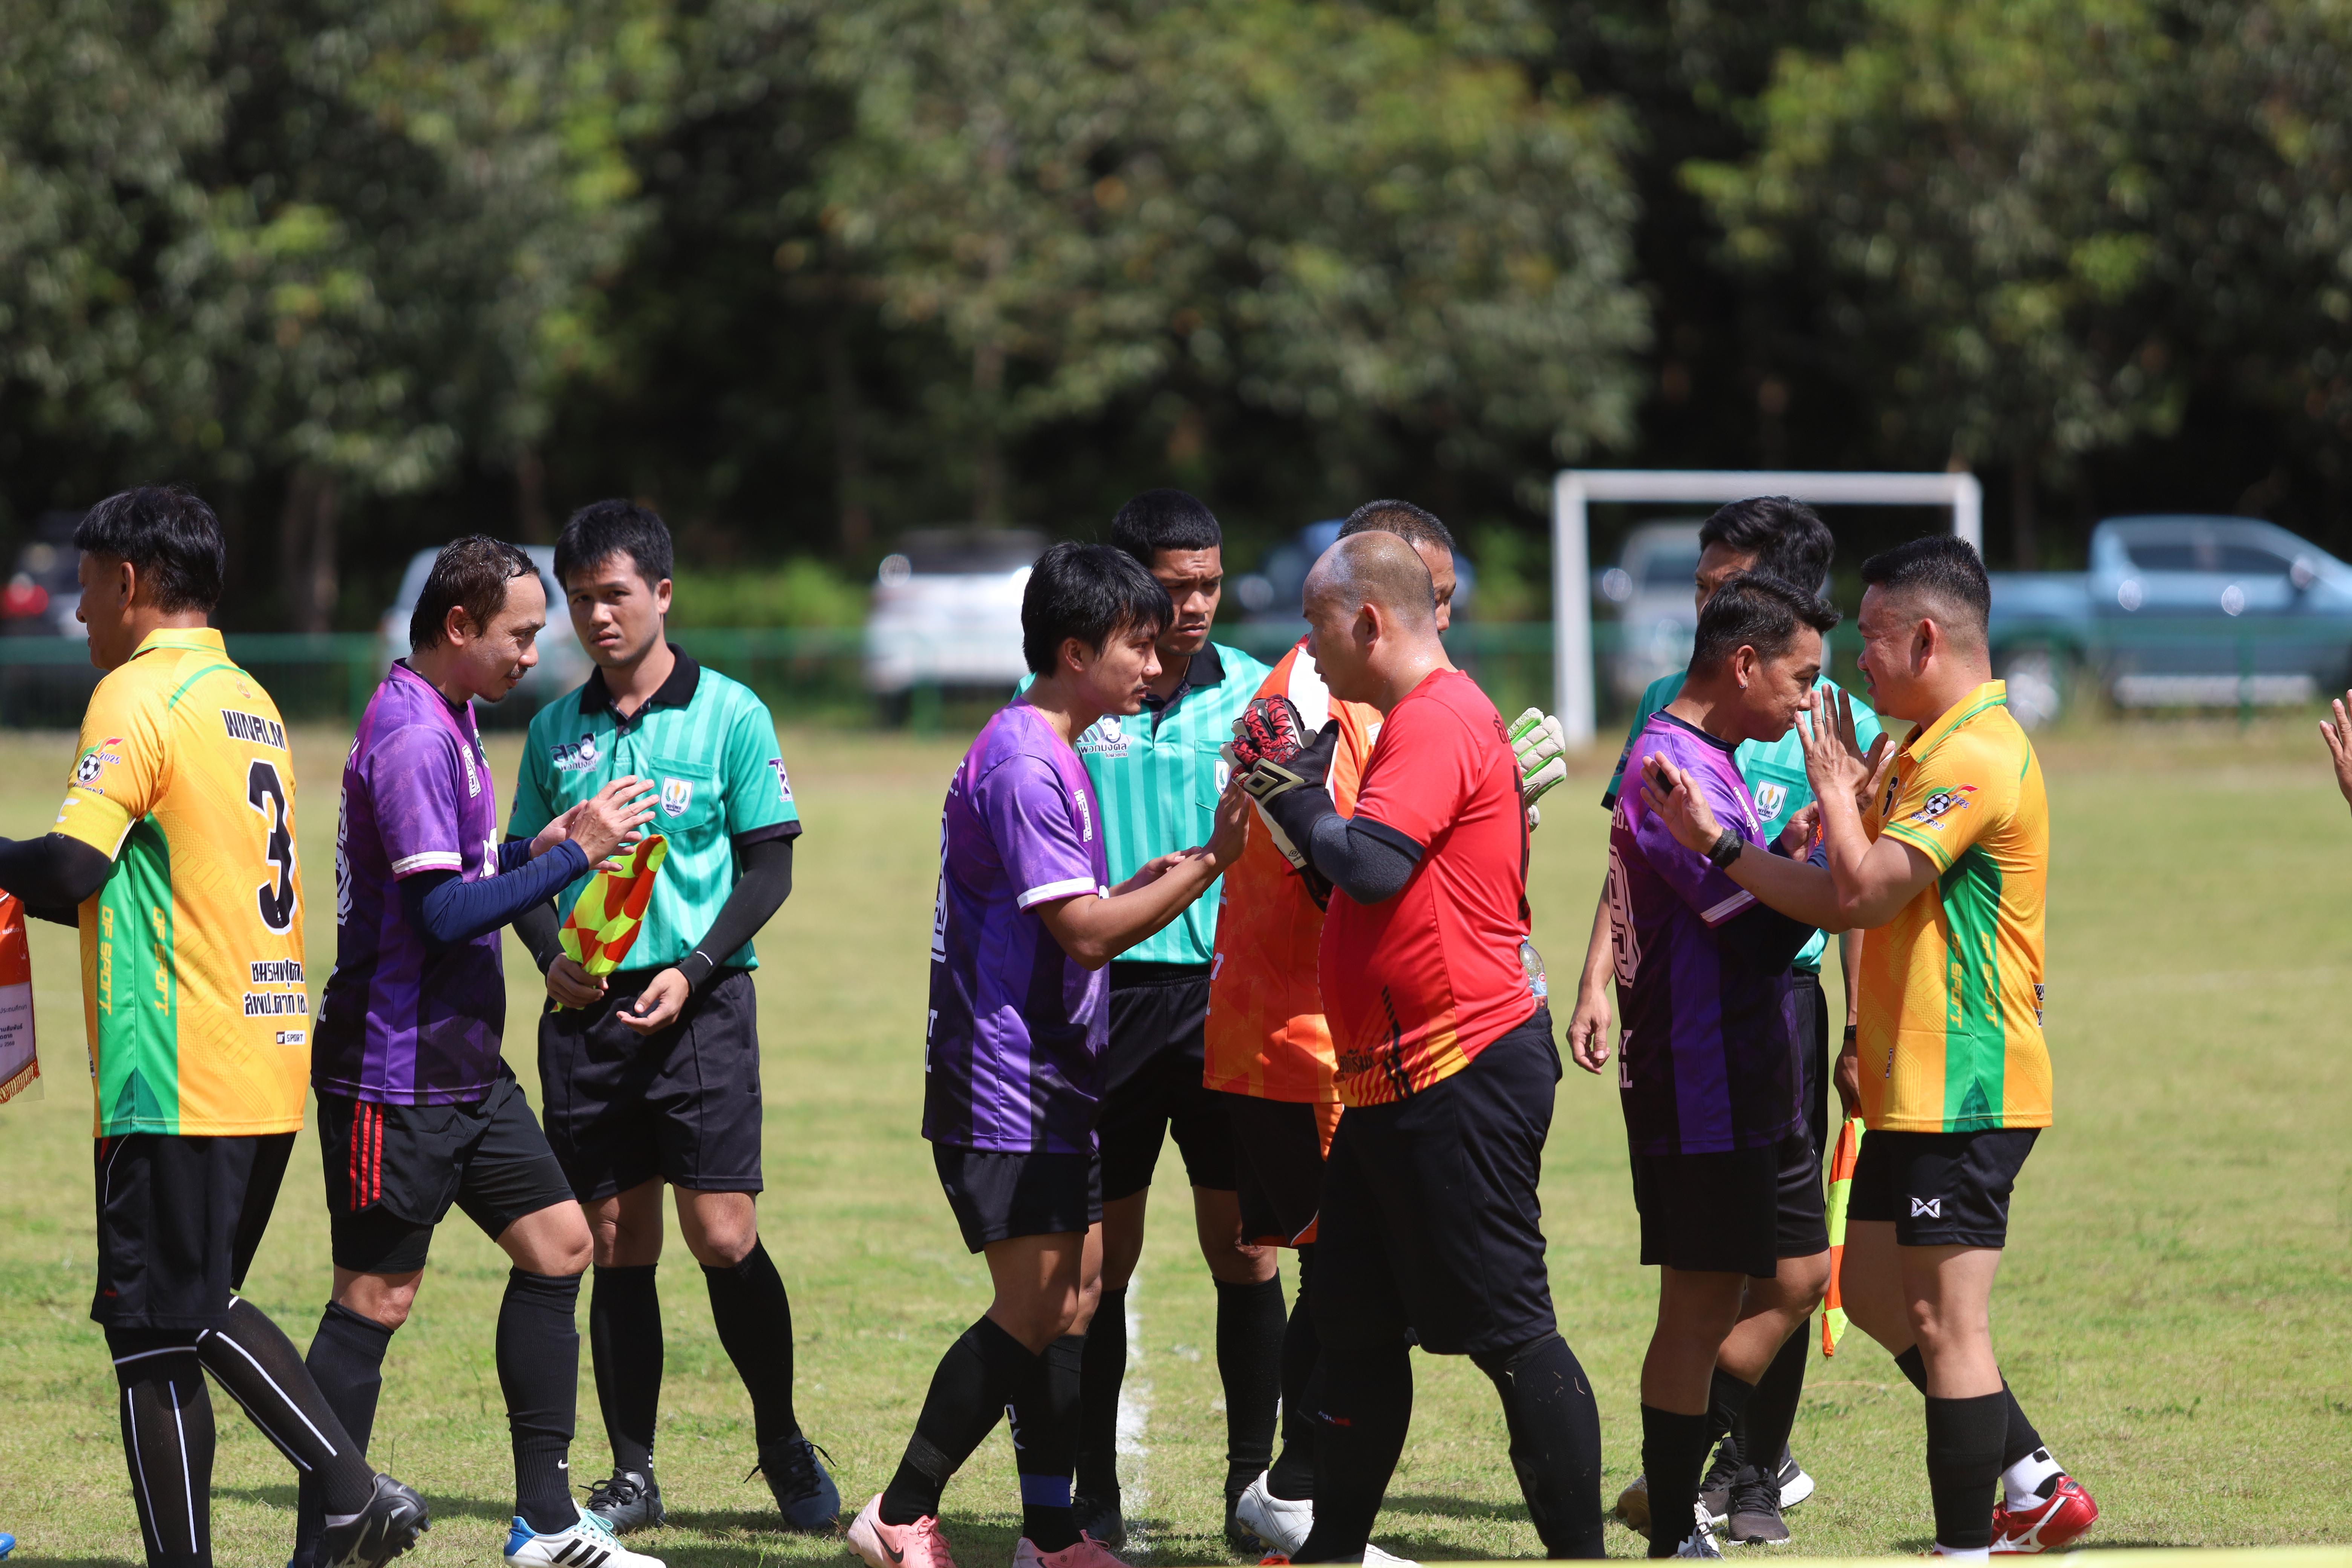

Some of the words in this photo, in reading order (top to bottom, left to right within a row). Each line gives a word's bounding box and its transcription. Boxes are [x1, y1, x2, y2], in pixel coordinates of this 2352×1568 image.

[99, 752, 120, 764] 2025
[1081, 743, 1127, 753] พวกมงคล
[1950, 795, 1970, 809] 2025
[248, 759, 296, 934] 3
[102, 905, 113, 939] DF
[153, 906, 165, 940] DF
[99, 942, 112, 1016] SPORT
[154, 943, 168, 1017] SPORT
[1949, 962, 1962, 1029] SPORT
